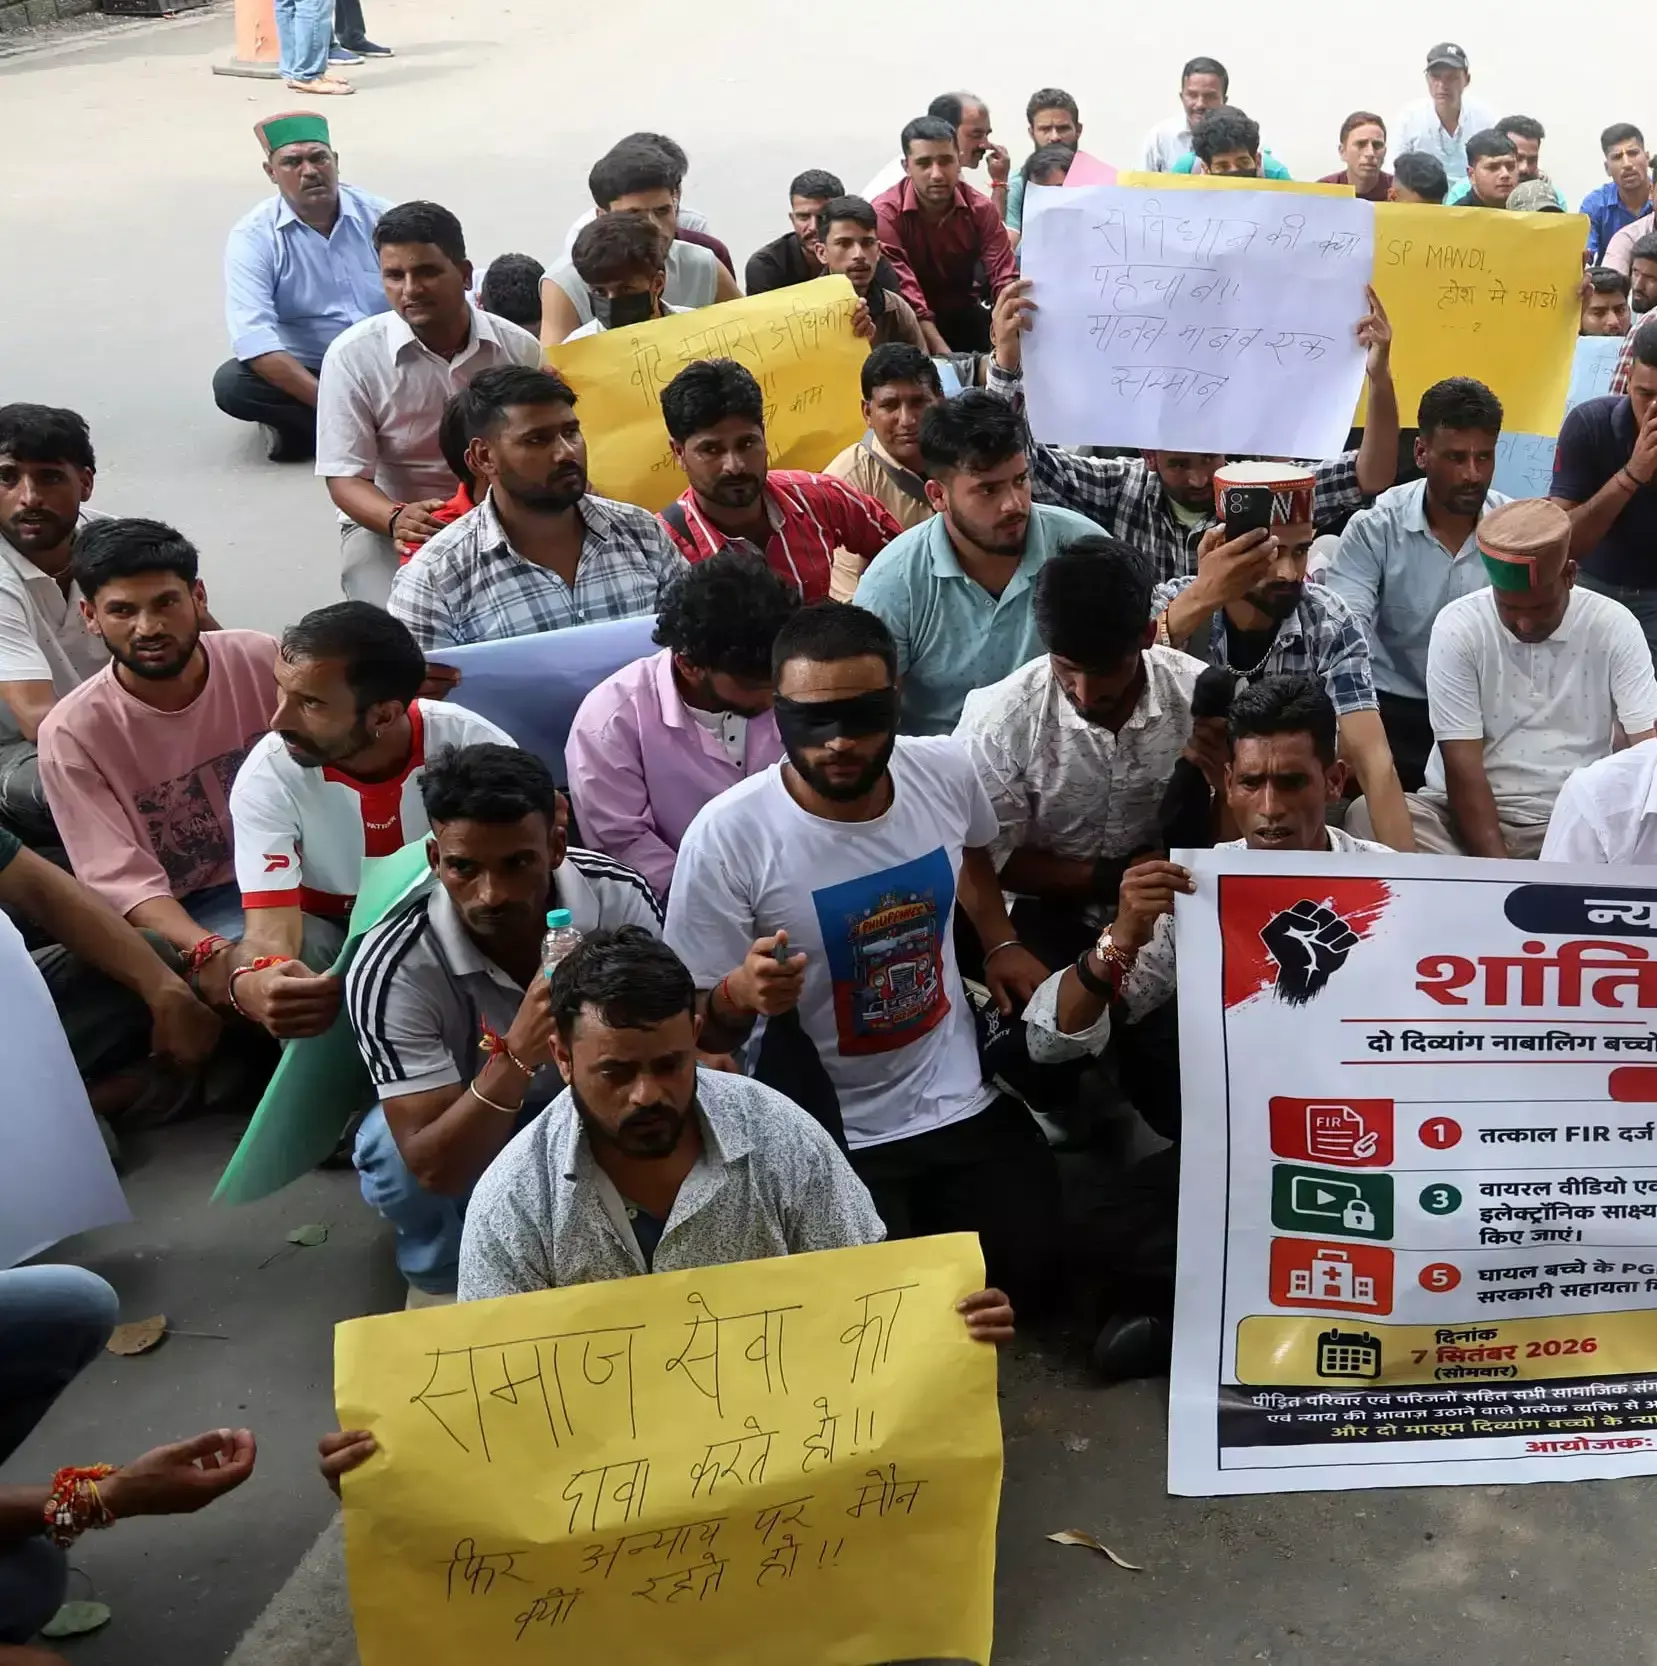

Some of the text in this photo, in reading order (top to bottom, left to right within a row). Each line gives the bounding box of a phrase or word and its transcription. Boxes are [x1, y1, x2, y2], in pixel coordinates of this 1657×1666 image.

[1385, 240, 1413, 266] SP
[1366, 1030, 1394, 1052] दो
[1400, 1030, 1485, 1052] दिव्यांग
[1491, 1031, 1597, 1051] नाबालिग
[1317, 1117, 1340, 1127] FIR
[1434, 1125, 1444, 1141] 1
[1479, 1128, 1558, 1143] तत्काल
[1566, 1126, 1610, 1142] FIR
[1618, 1122, 1655, 1142] दर्ज
[1432, 1190, 1448, 1208] 3
[1479, 1182, 1552, 1196] वायरल
[1558, 1176, 1627, 1195] वीडियो
[1479, 1202, 1595, 1224] इलेक्ट्रॉनिक
[1601, 1205, 1657, 1219] साक्ष्य
[1479, 1227, 1524, 1245] किए
[1435, 1327, 1498, 1347] दिनांक
[1411, 1338, 1597, 1364] 7 सितंबर 2026
[410, 1325, 646, 1462] समाज
[839, 1283, 920, 1384] का
[1434, 1365, 1517, 1380] (सोमवार)
[1305, 1392, 1361, 1408] परिवार
[1367, 1391, 1389, 1406] एवं
[1397, 1390, 1456, 1405] परिजनों
[1462, 1388, 1507, 1403] सहित
[1512, 1387, 1546, 1399] सभी
[1551, 1383, 1628, 1398] सामाजिक
[690, 1416, 780, 1498] करते
[439, 1537, 533, 1601] फिर
[581, 1517, 728, 1580] अन्याय
[756, 1495, 815, 1532] पर
